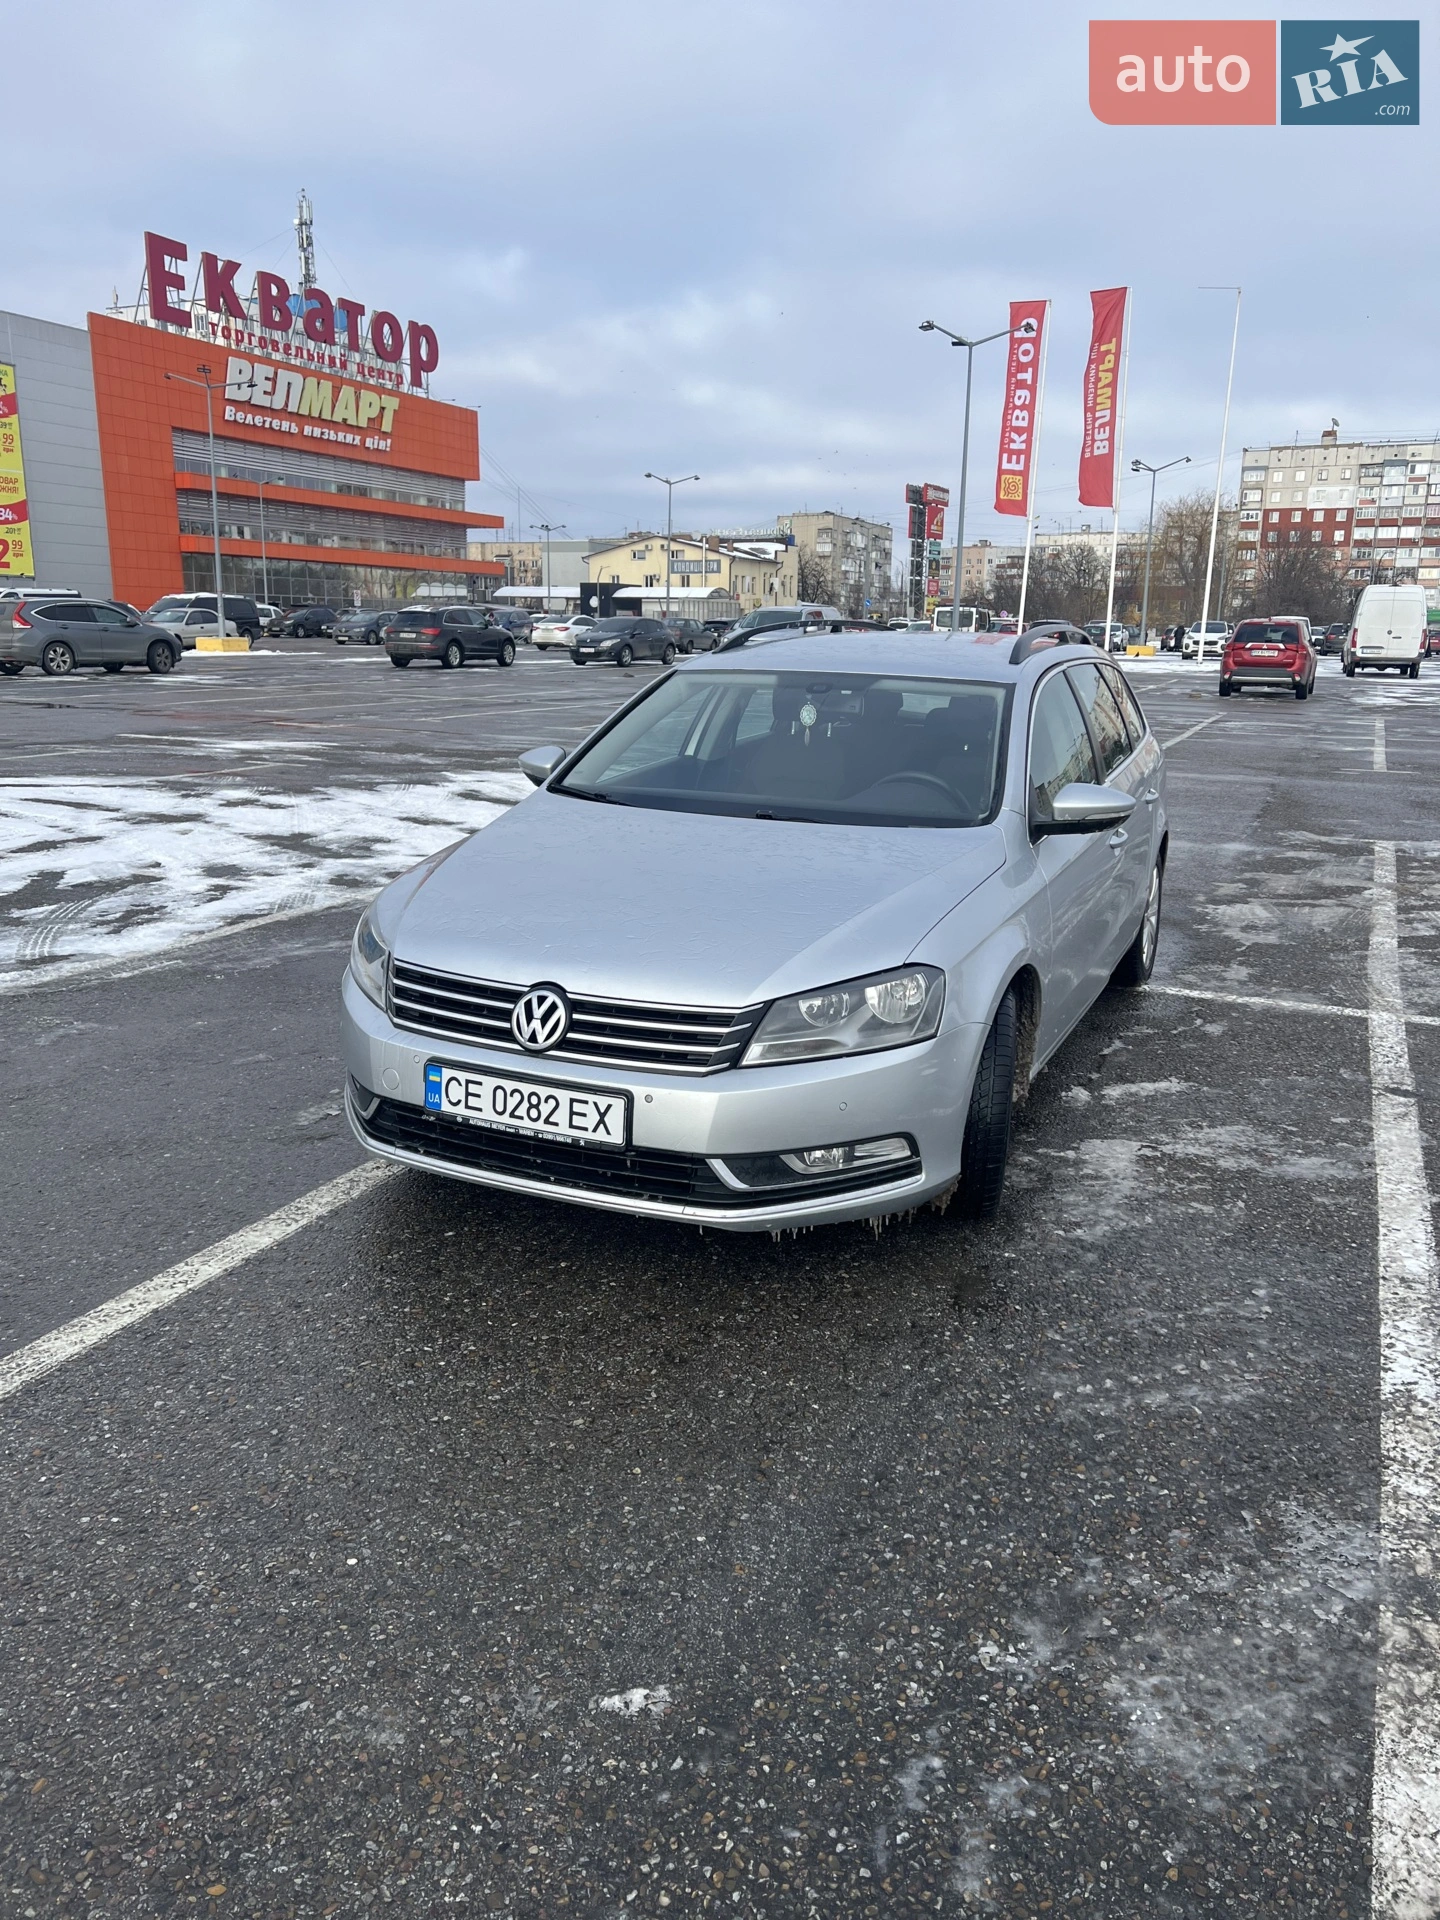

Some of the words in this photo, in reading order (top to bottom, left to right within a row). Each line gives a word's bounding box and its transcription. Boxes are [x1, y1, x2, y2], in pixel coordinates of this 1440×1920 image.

[208, 321, 348, 372] торговельний
[356, 360, 404, 388] центр
[225, 356, 400, 433] ВЕЛМАРТ
[224, 405, 299, 434] Велетень
[303, 425, 361, 446] низьких
[365, 435, 392, 452] цін!
[673, 561, 718, 572] КОНДИЦІОЕРИ
[428, 1092, 440, 1104] UA
[444, 1076, 483, 1112] CE
[492, 1085, 560, 1127] 0282
[568, 1097, 613, 1136] EX
